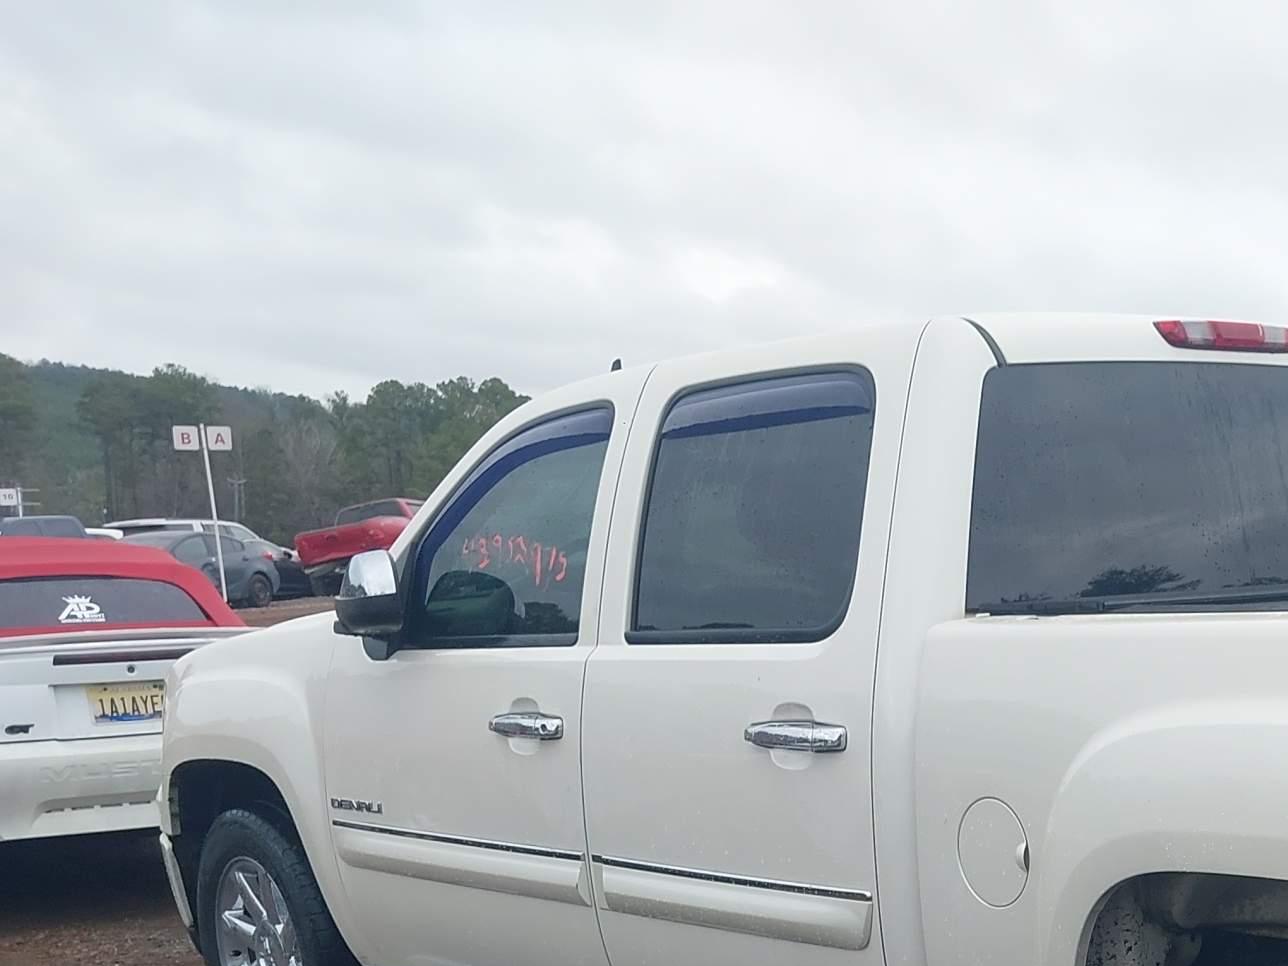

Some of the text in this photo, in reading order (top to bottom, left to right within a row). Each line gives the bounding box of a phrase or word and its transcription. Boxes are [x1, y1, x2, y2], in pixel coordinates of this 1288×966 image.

[180, 431, 192, 446] B
[214, 432, 226, 446] A
[98, 694, 164, 716] 1A1AYE
[330, 797, 384, 815] DENALI
